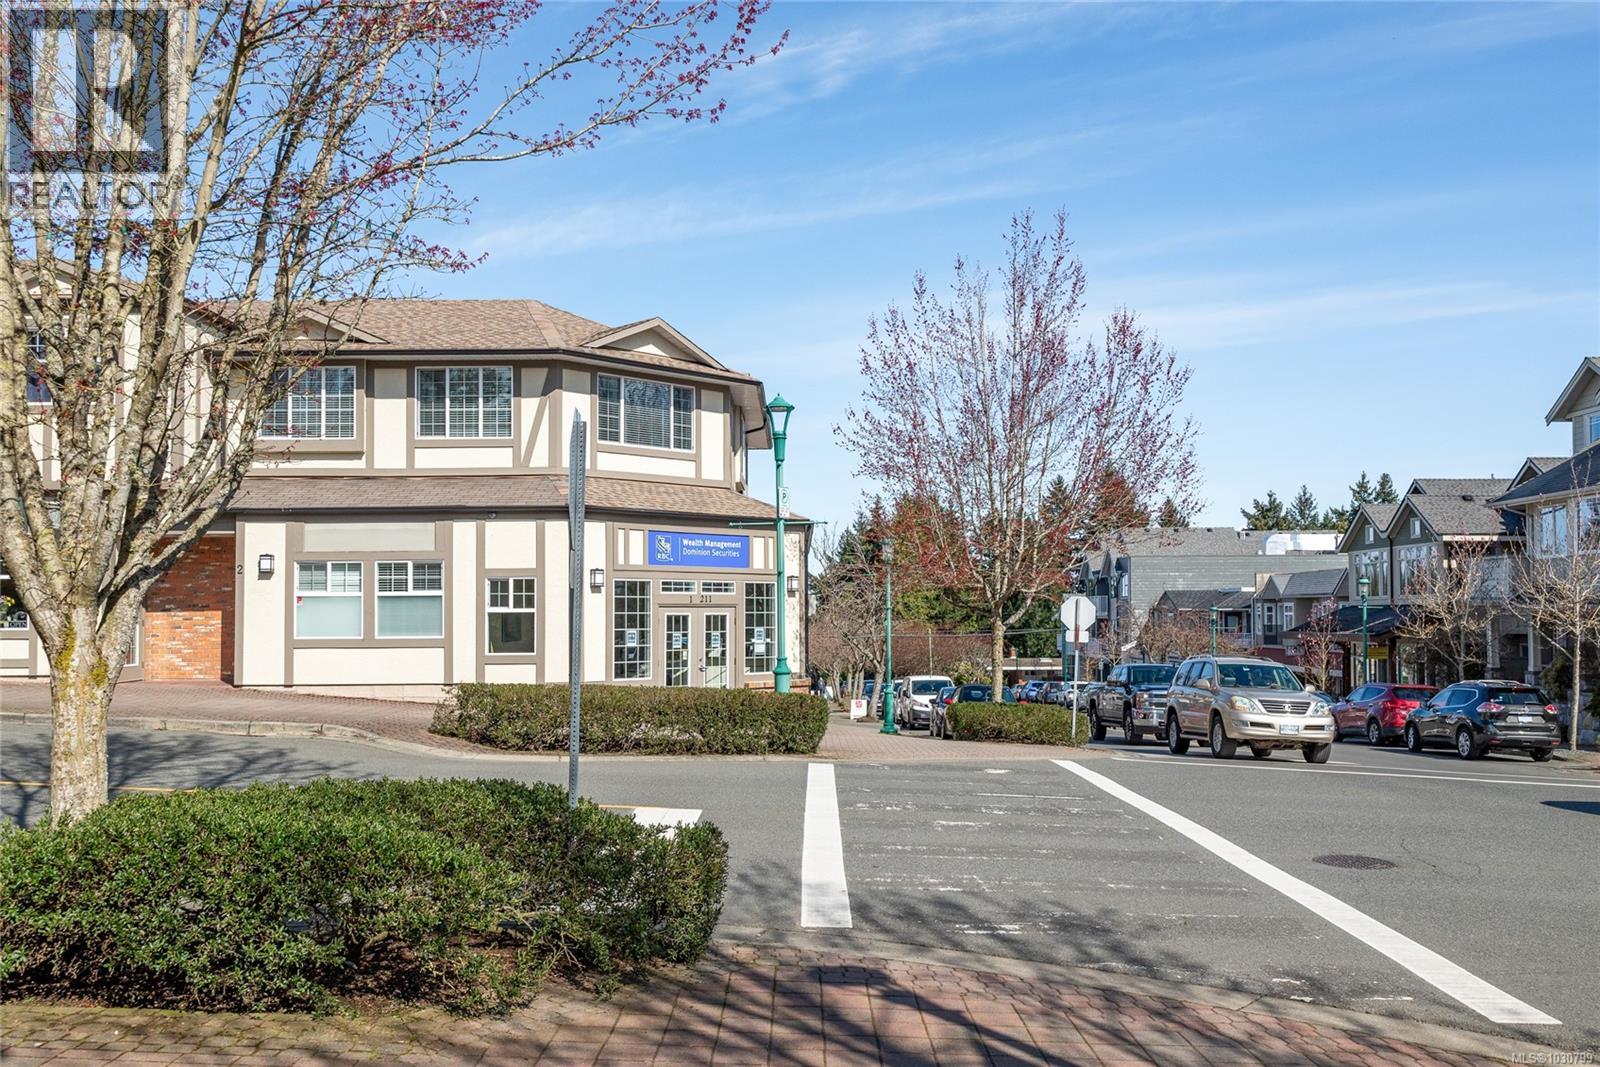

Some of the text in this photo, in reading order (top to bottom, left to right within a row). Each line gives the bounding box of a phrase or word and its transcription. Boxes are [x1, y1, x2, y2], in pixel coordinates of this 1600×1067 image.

[682, 539, 741, 549] Wealth Management
[682, 548, 740, 557] Dominion Securities
[237, 564, 243, 575] 2
[700, 595, 712, 603] 211
